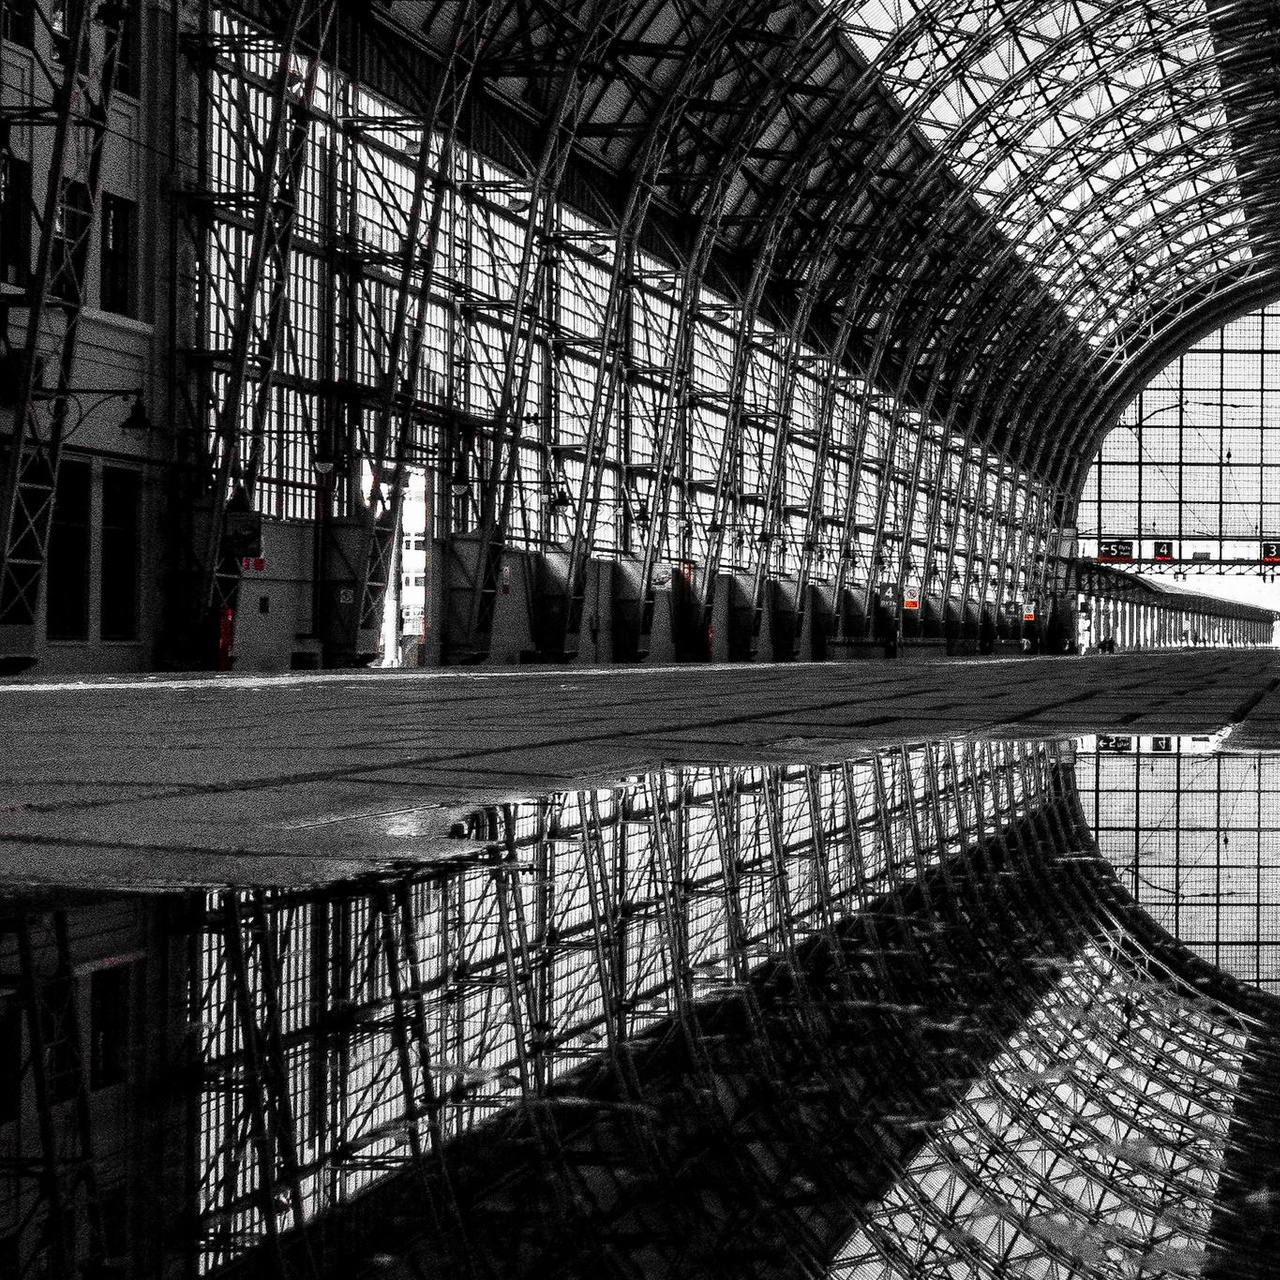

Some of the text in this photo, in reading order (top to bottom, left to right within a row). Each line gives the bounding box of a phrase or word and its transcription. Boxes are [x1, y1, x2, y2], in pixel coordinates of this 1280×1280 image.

[1110, 544, 1118, 556] 5
[1160, 544, 1168, 555] 4
[1269, 545, 1277, 556] 3
[885, 586, 893, 598] 4
